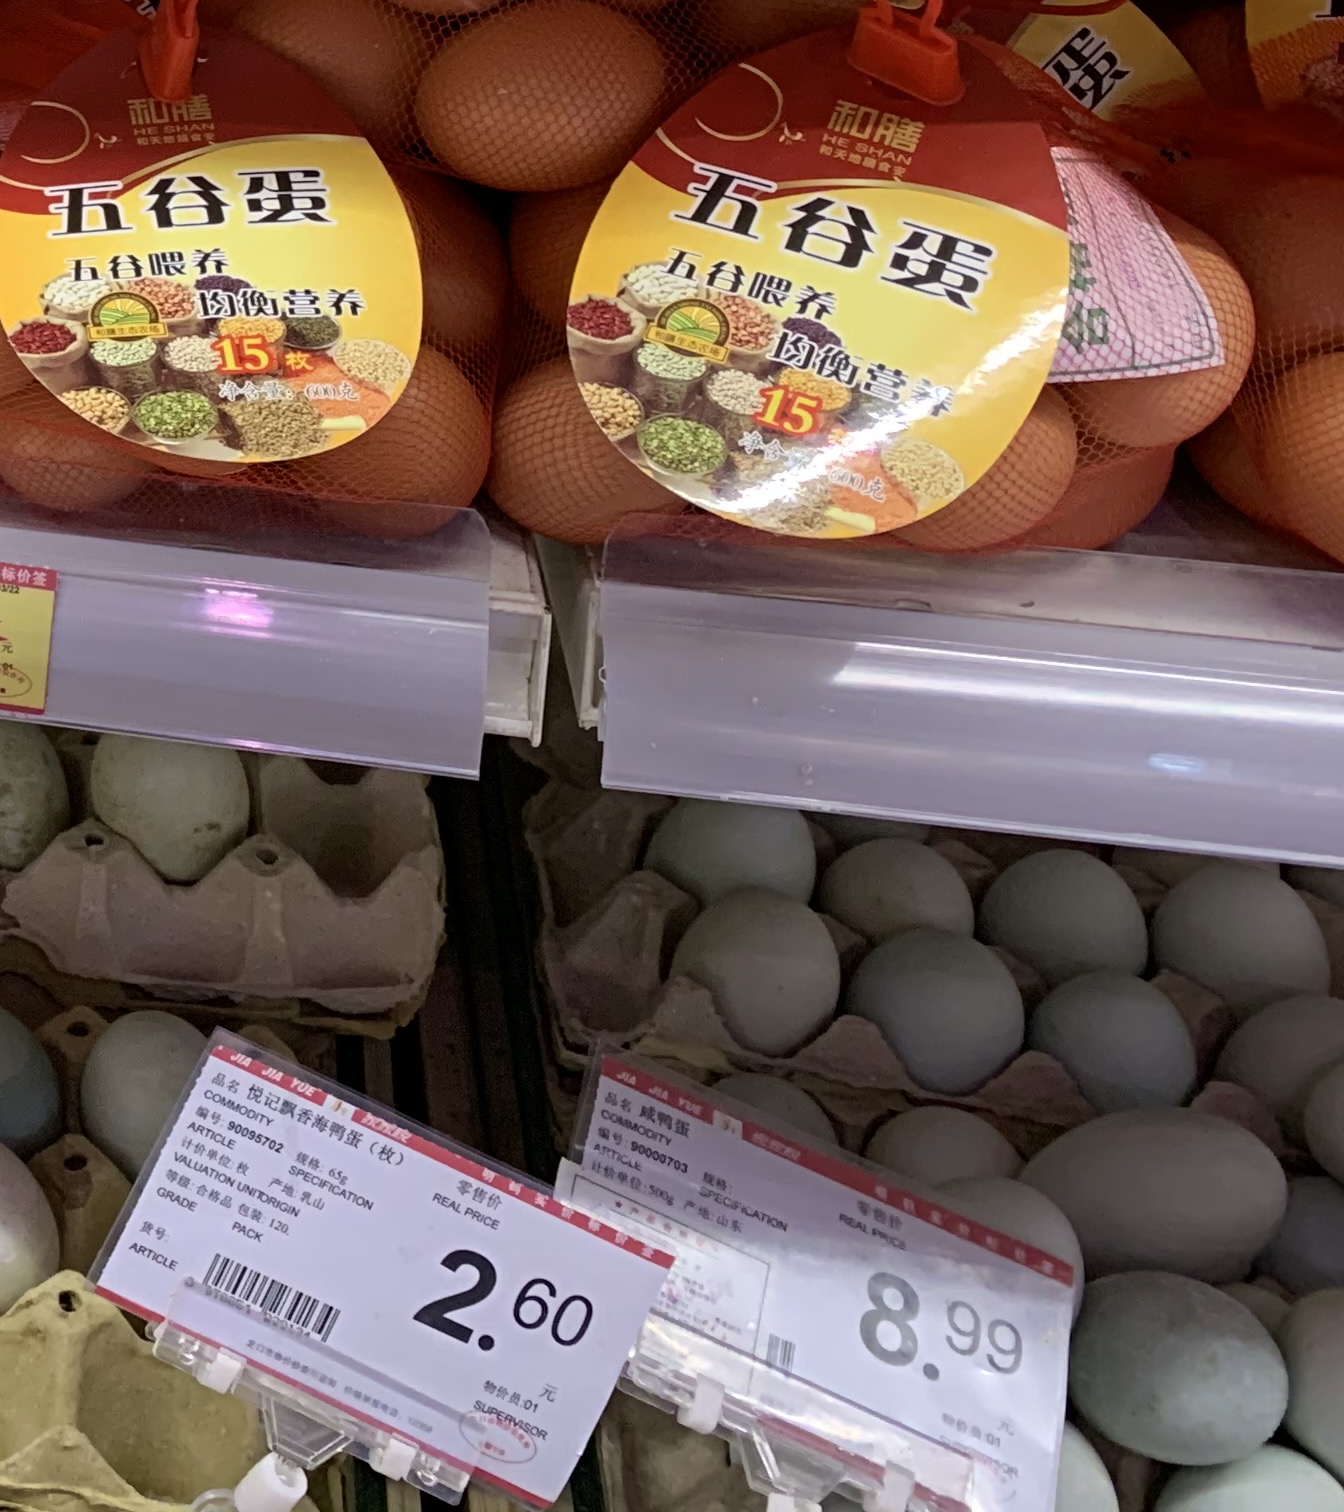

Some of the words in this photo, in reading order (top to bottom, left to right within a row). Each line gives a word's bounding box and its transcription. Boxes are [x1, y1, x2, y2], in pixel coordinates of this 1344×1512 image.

[127, 94, 212, 125] 和膳
[133, 127, 159, 136] HE
[166, 122, 215, 133] SHAN
[828, 99, 926, 154] 和膳
[823, 134, 850, 148] HE
[855, 142, 912, 166] SHAN
[48, 166, 336, 239] 五谷蛋
[674, 165, 996, 313] 五谷蛋
[66, 246, 231, 282] 五谷喂养
[663, 248, 840, 322] 五谷喂养
[196, 287, 367, 320] 均衡营养
[212, 333, 271, 377] 15
[285, 347, 315, 374] 枚
[771, 331, 957, 418] 均衡营养
[755, 386, 822, 435] 15
[2, 642, 14, 654] 元
[230, 1052, 252, 1068] JIA
[262, 1066, 284, 1082] JIA
[289, 1078, 317, 1097] YUE
[616, 1072, 637, 1085] JIA
[649, 1086, 669, 1101] JIA
[195, 1105, 226, 1128] 编号:
[226, 1120, 284, 1154] 90095702
[328, 1166, 350, 1186] 65g
[211, 1072, 241, 1094] 品名
[246, 1084, 406, 1166] 悦记飘香海鸭蛋（枚）
[456, 1179, 503, 1211] 零售价
[600, 1109, 672, 1147] COMMODITY
[174, 1151, 234, 1188] VALUATION
[186, 1121, 237, 1150] ARTICLE
[288, 1164, 374, 1211] SPECIFICATION
[203, 1089, 275, 1127] COMMODITY
[432, 1192, 463, 1215] REAL
[464, 1208, 501, 1231] PRICE
[630, 1140, 689, 1174] 90000703
[593, 1143, 643, 1172] ARTICLE
[699, 1186, 788, 1232] SPECIFICATION
[156, 1187, 199, 1213] GRADE
[232, 1221, 264, 1243] PACK
[128, 1242, 178, 1272] ARTICLE
[412, 1248, 594, 1352] 2.60
[859, 1271, 1024, 1382] 8.99
[538, 1384, 558, 1404] 元
[473, 1400, 548, 1441] SUPERVISOR
